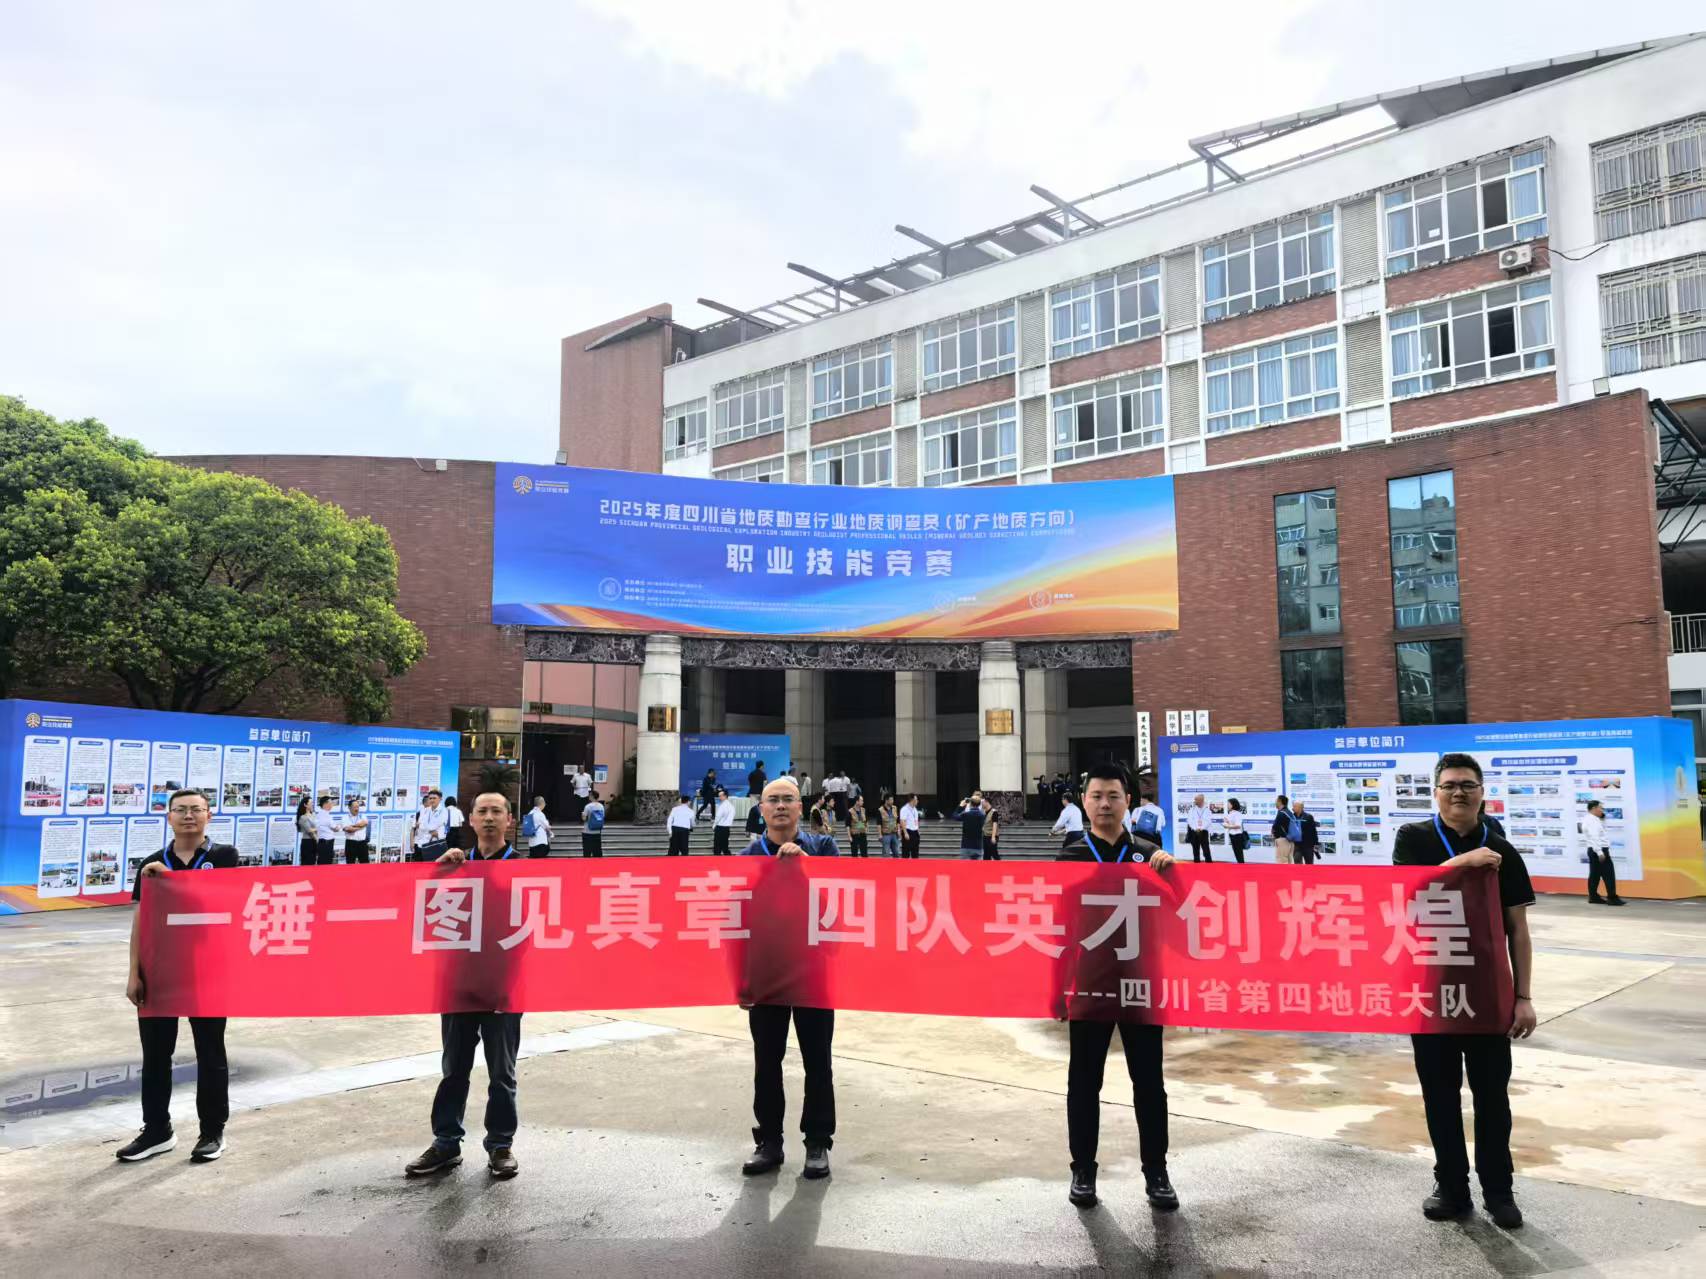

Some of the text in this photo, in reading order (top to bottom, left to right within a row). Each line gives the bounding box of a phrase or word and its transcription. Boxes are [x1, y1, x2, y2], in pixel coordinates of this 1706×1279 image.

[726, 543, 953, 577] 职业技能竞赛
[1334, 735, 1405, 749] 参赛单位简介
[166, 871, 1476, 967] 一锤一图见真章 四队英才创辉煌
